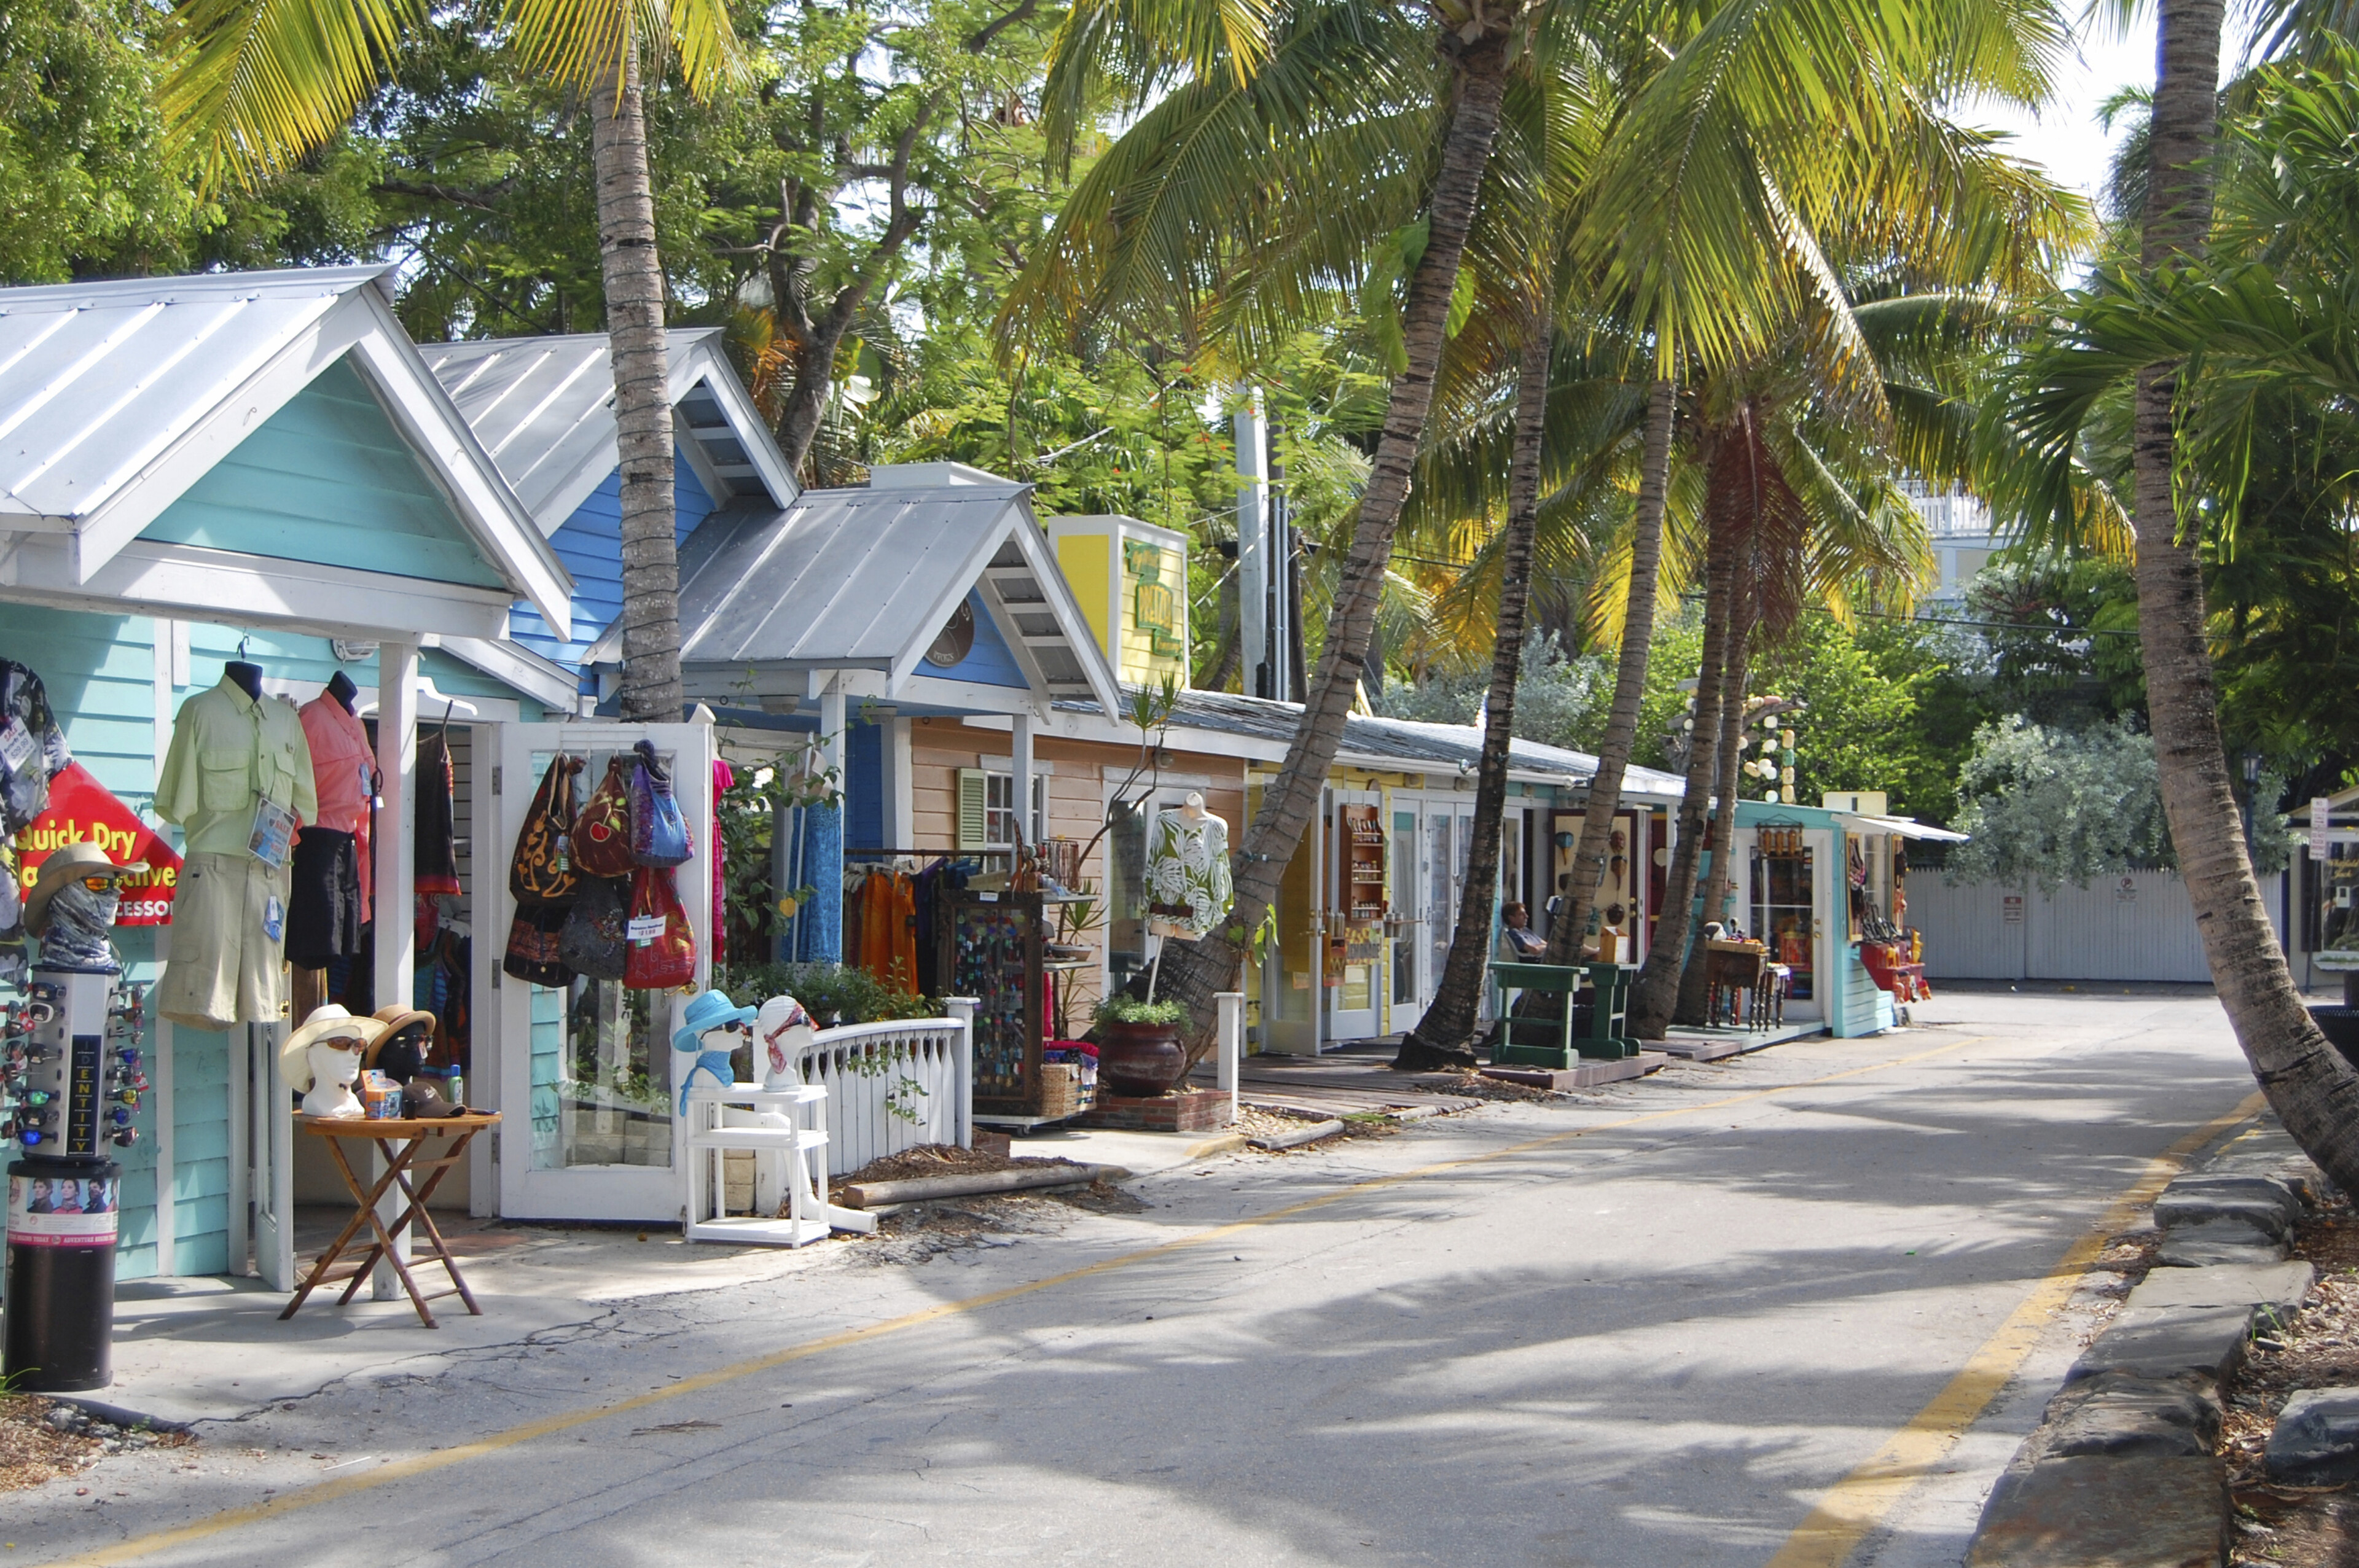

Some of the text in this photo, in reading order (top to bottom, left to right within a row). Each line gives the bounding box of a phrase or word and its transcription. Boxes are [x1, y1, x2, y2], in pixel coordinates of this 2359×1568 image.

[15, 819, 137, 860] Quick Dry
[117, 899, 174, 916] CESSO
